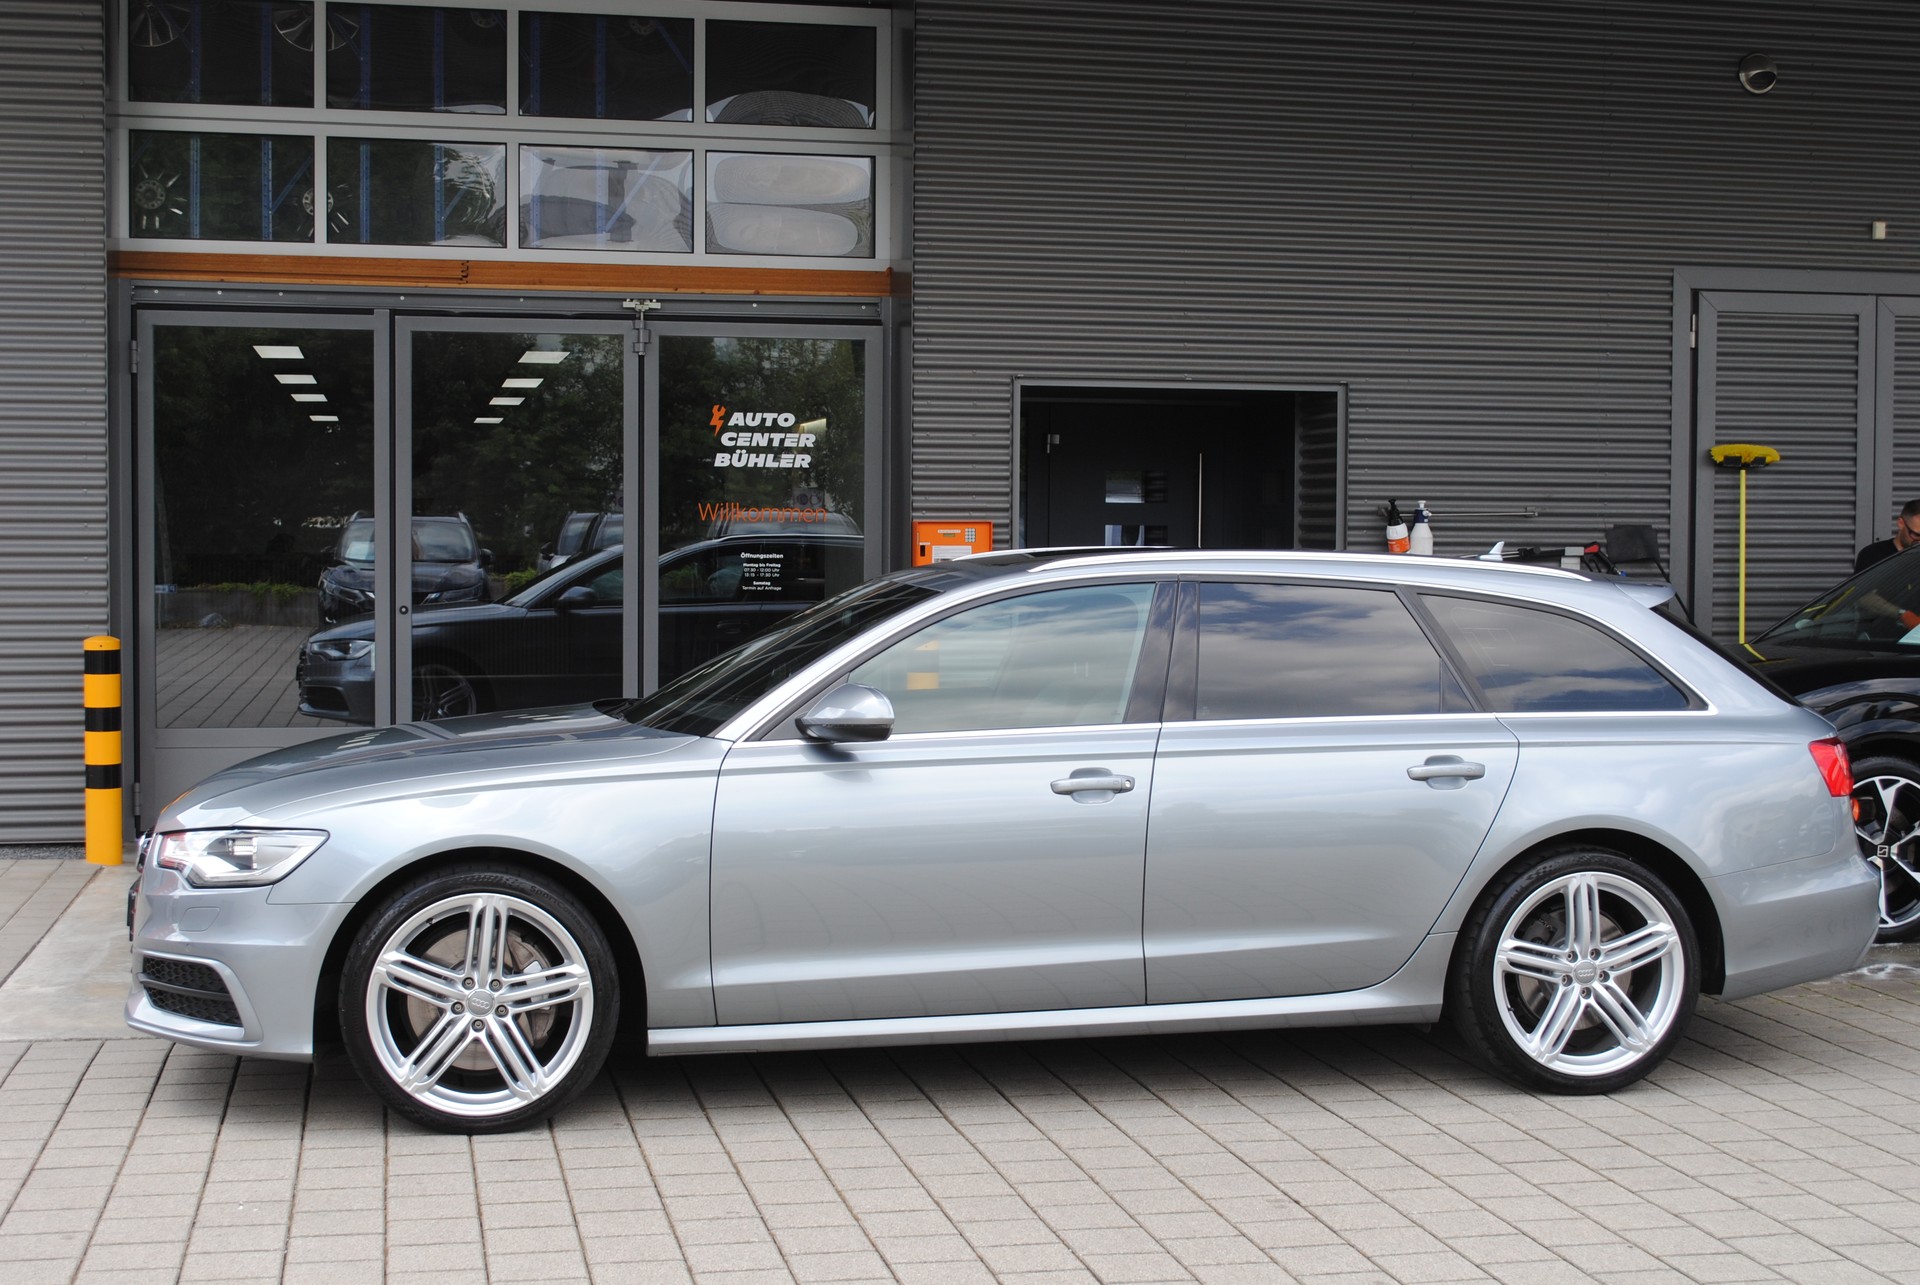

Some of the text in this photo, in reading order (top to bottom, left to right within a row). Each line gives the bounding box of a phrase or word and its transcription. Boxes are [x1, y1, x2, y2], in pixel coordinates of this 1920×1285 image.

[728, 412, 796, 427] AUTO
[720, 432, 816, 447] CENTER
[714, 449, 812, 468] BÜHLER
[698, 502, 826, 522] Willkommen
[740, 552, 784, 560] Öffnungszeiten
